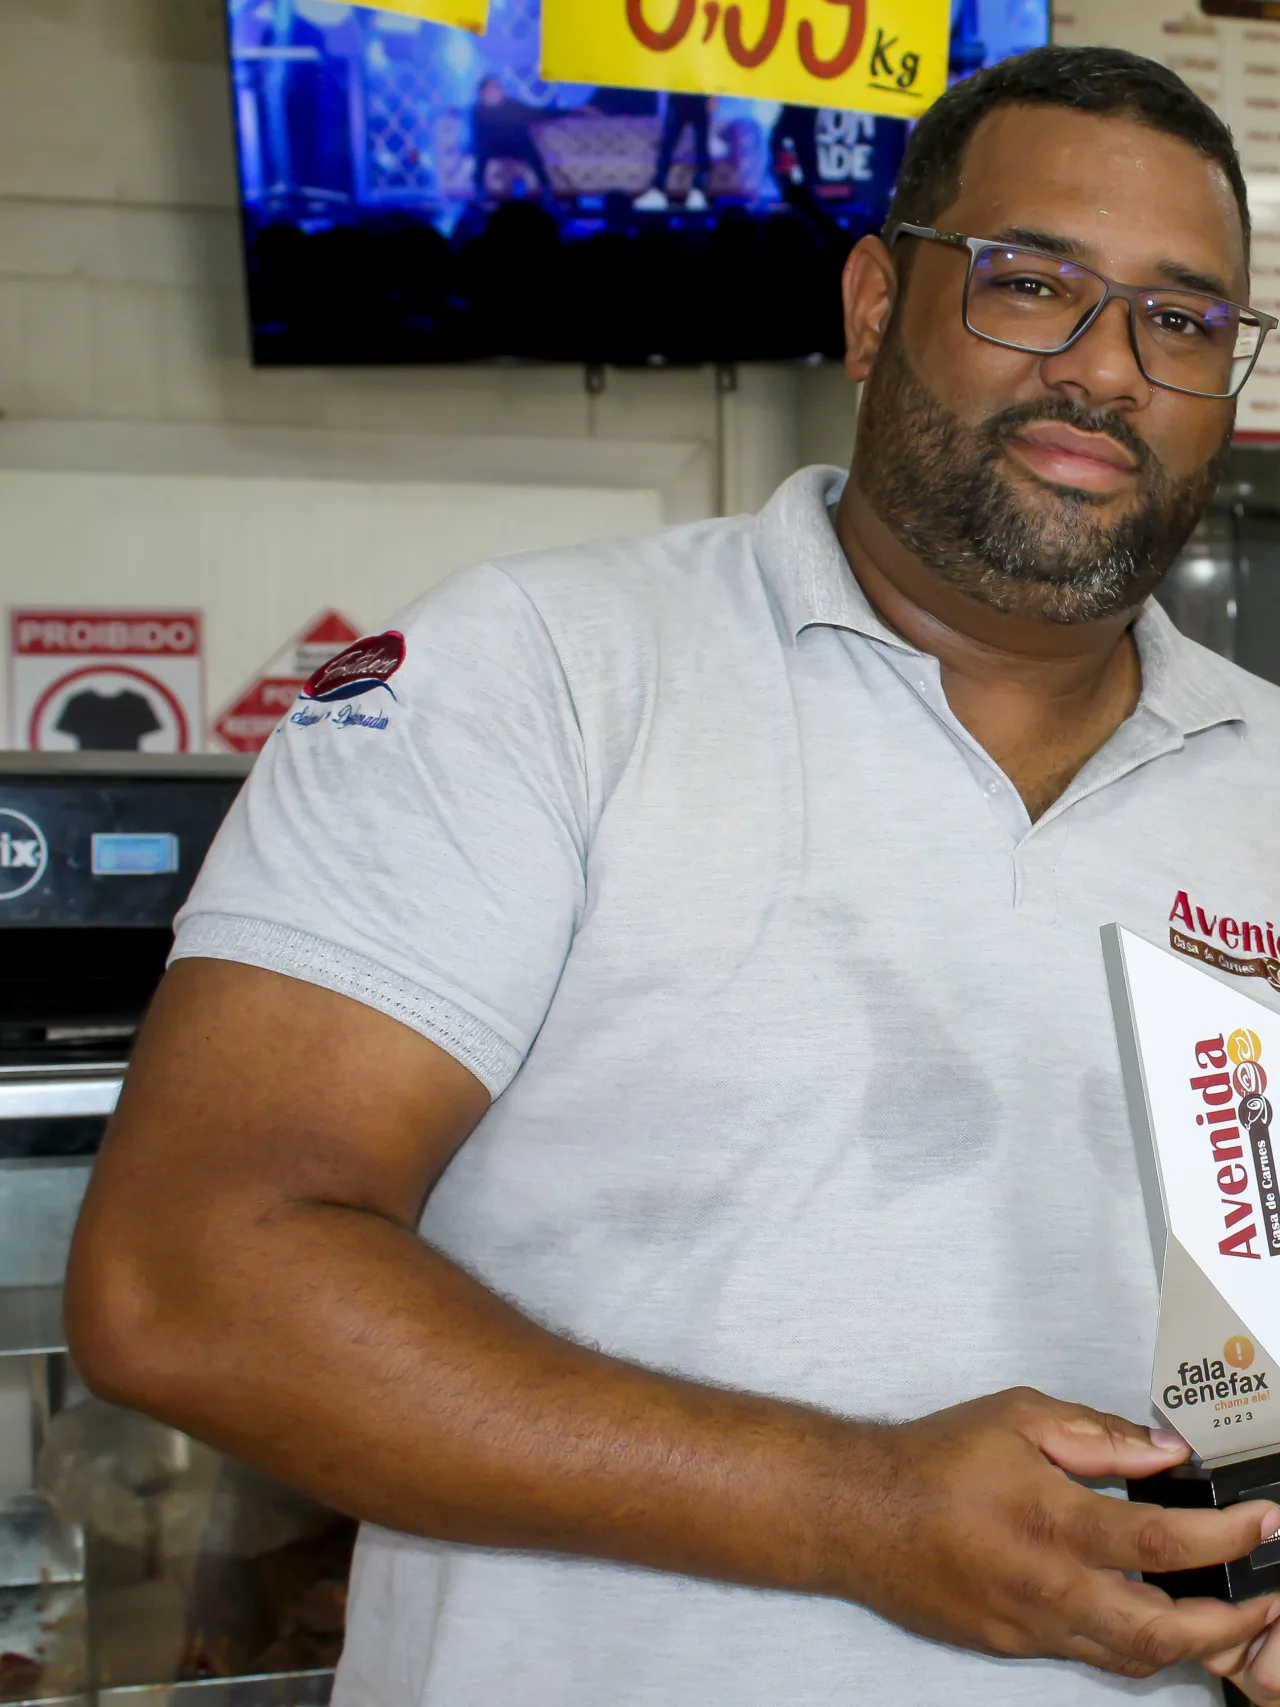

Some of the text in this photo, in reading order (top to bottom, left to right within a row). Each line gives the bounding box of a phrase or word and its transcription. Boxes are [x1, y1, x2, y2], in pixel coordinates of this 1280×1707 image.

[868, 27, 921, 88] Kg
[18, 619, 194, 651] PROIBIDO
[1173, 934, 1200, 955] Casa
[1218, 954, 1256, 974] Carnes
[1189, 1032, 1262, 1260] Avenida
[1257, 1139, 1273, 1190] Carnes
[1265, 1191, 1277, 1210] de
[1178, 1357, 1226, 1387] fala
[1163, 1372, 1269, 1410] Genefax
[1214, 1396, 1249, 1412] chama
[1213, 1411, 1254, 1429] 2023
